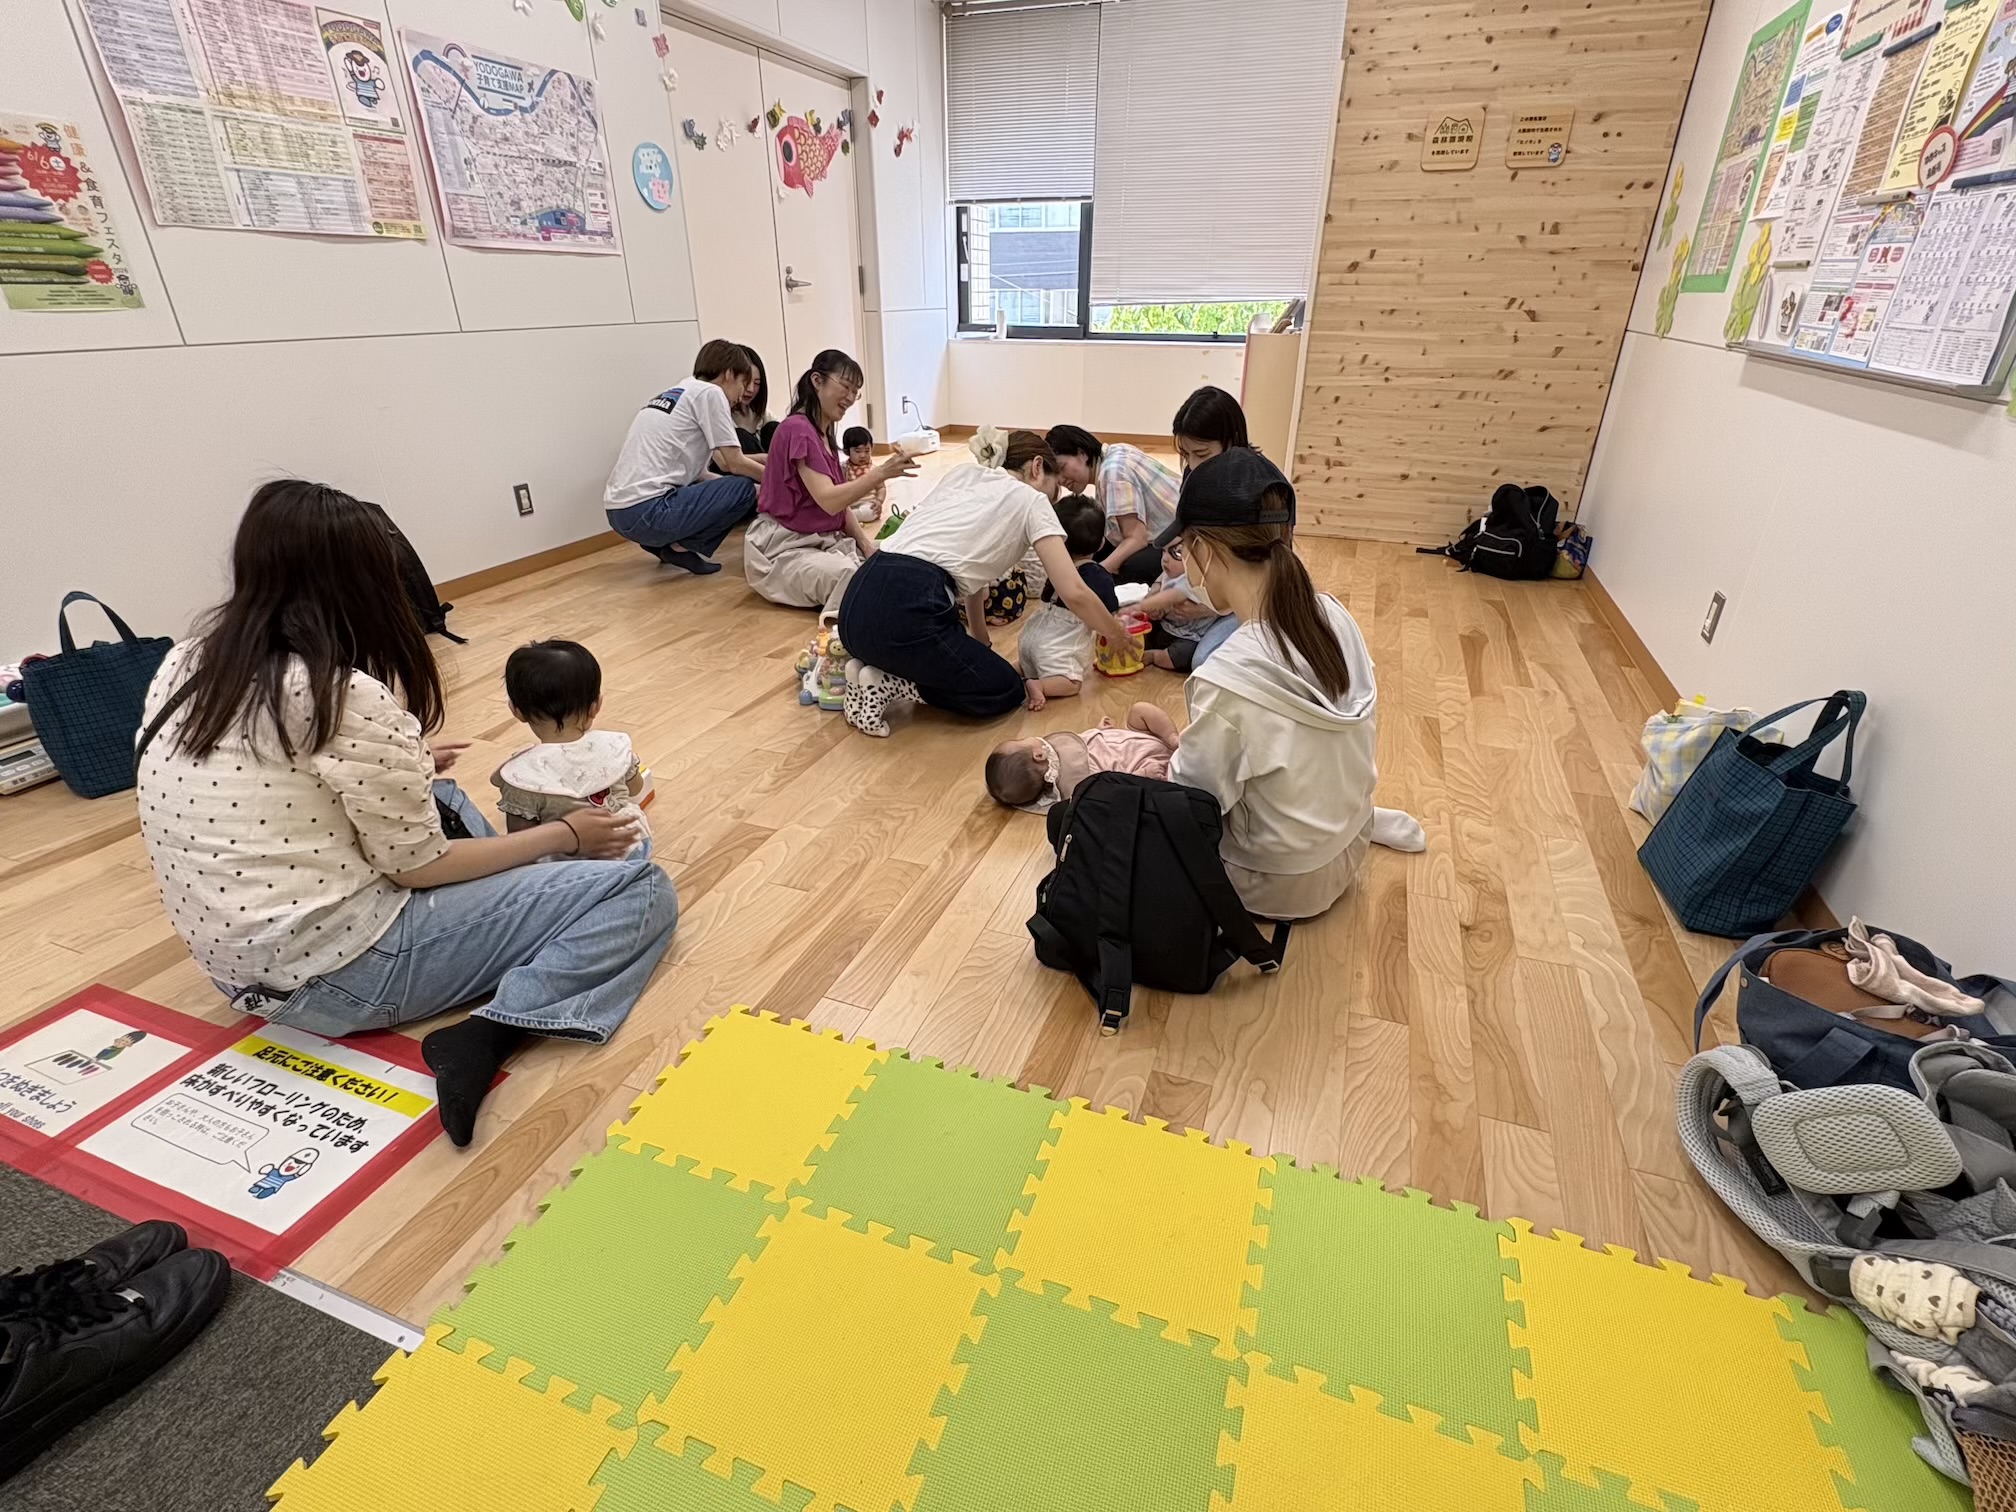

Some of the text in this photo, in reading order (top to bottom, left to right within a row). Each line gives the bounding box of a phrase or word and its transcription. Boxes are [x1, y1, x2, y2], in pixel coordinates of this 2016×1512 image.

[472, 60, 524, 83] YODOGAWA
[0, 1067, 77, 1113] つをぬぎましょう
[206, 1063, 369, 1134] 新しいフローリングのため、
[3, 1107, 26, 1118] your
[22, 1114, 46, 1129] shoes
[180, 1073, 370, 1154] 床がすべりやすくなっています
